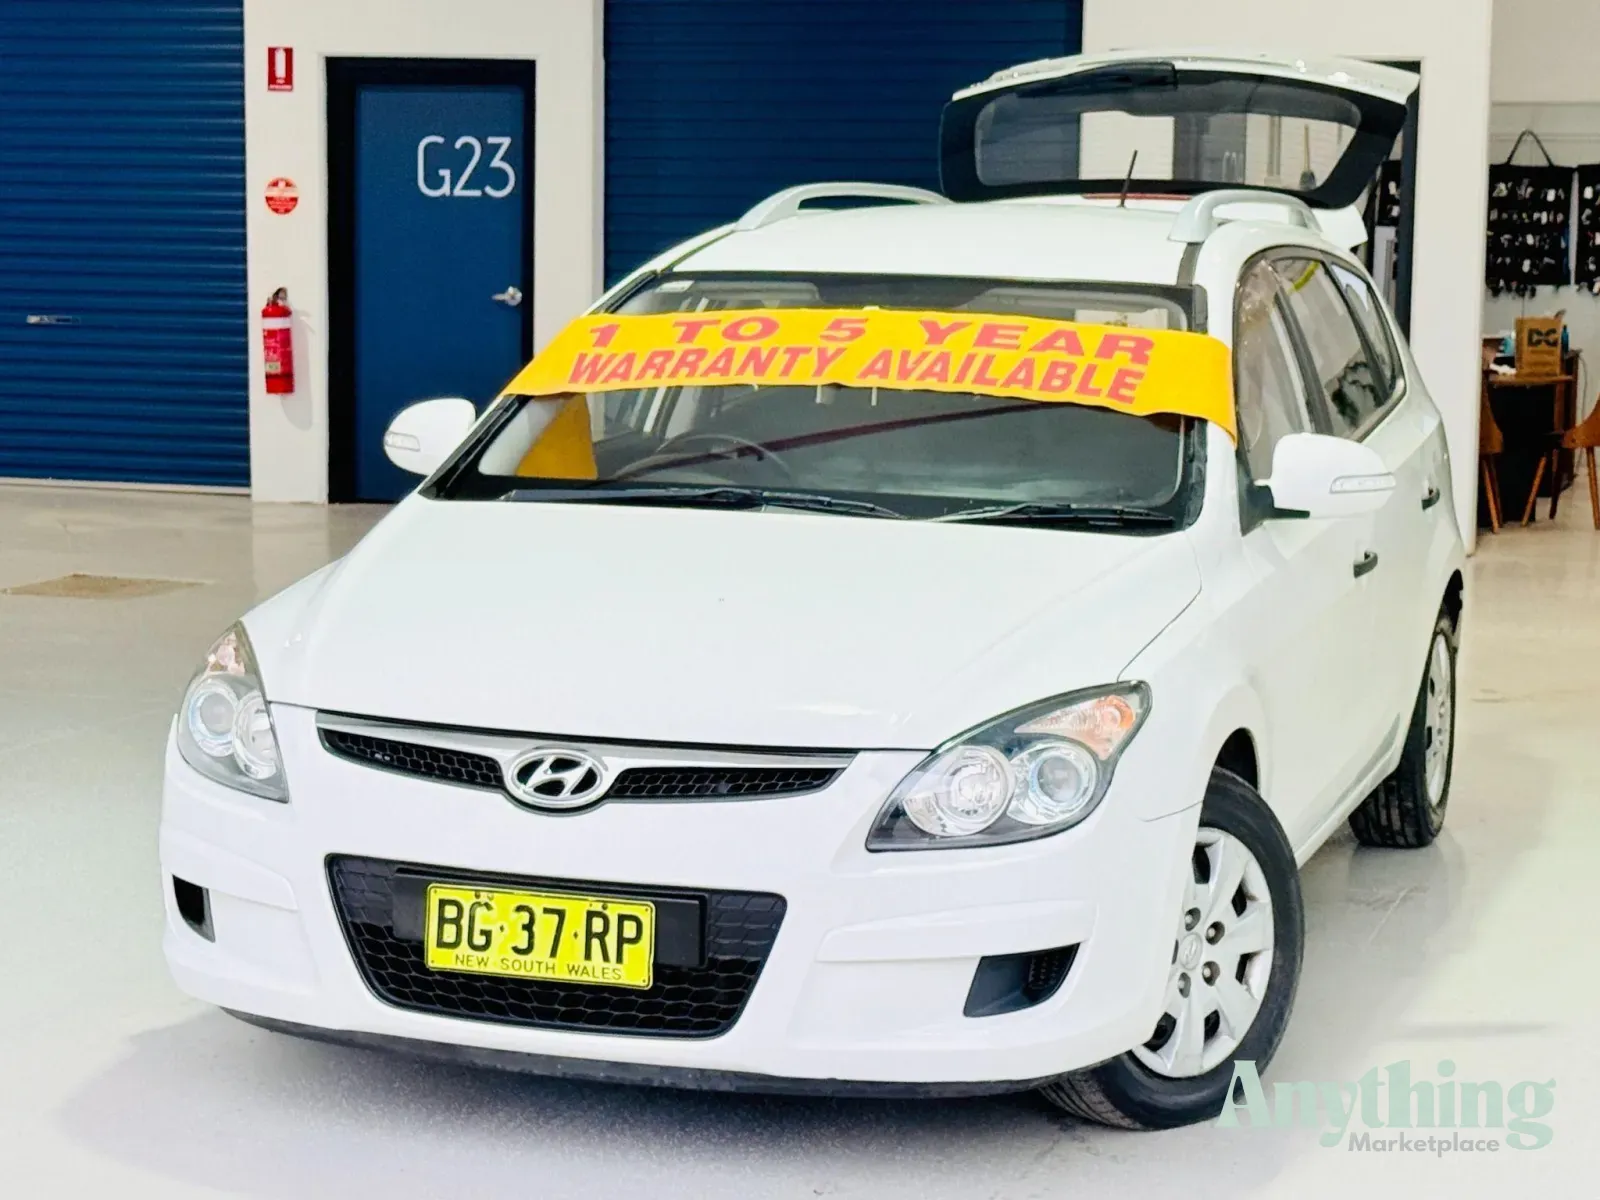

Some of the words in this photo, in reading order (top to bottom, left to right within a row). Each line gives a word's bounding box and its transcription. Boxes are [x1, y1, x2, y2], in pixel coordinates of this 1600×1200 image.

[417, 135, 516, 198] G23
[590, 324, 620, 348] 1
[672, 316, 780, 344] TO
[819, 318, 868, 343] 5
[919, 319, 1155, 366] YEAR
[568, 346, 847, 384] WARRANTY
[856, 349, 1145, 404] AVAILABLE
[455, 953, 490, 968] NEW
[500, 957, 556, 974] SOUTH
[566, 963, 622, 980] WALES
